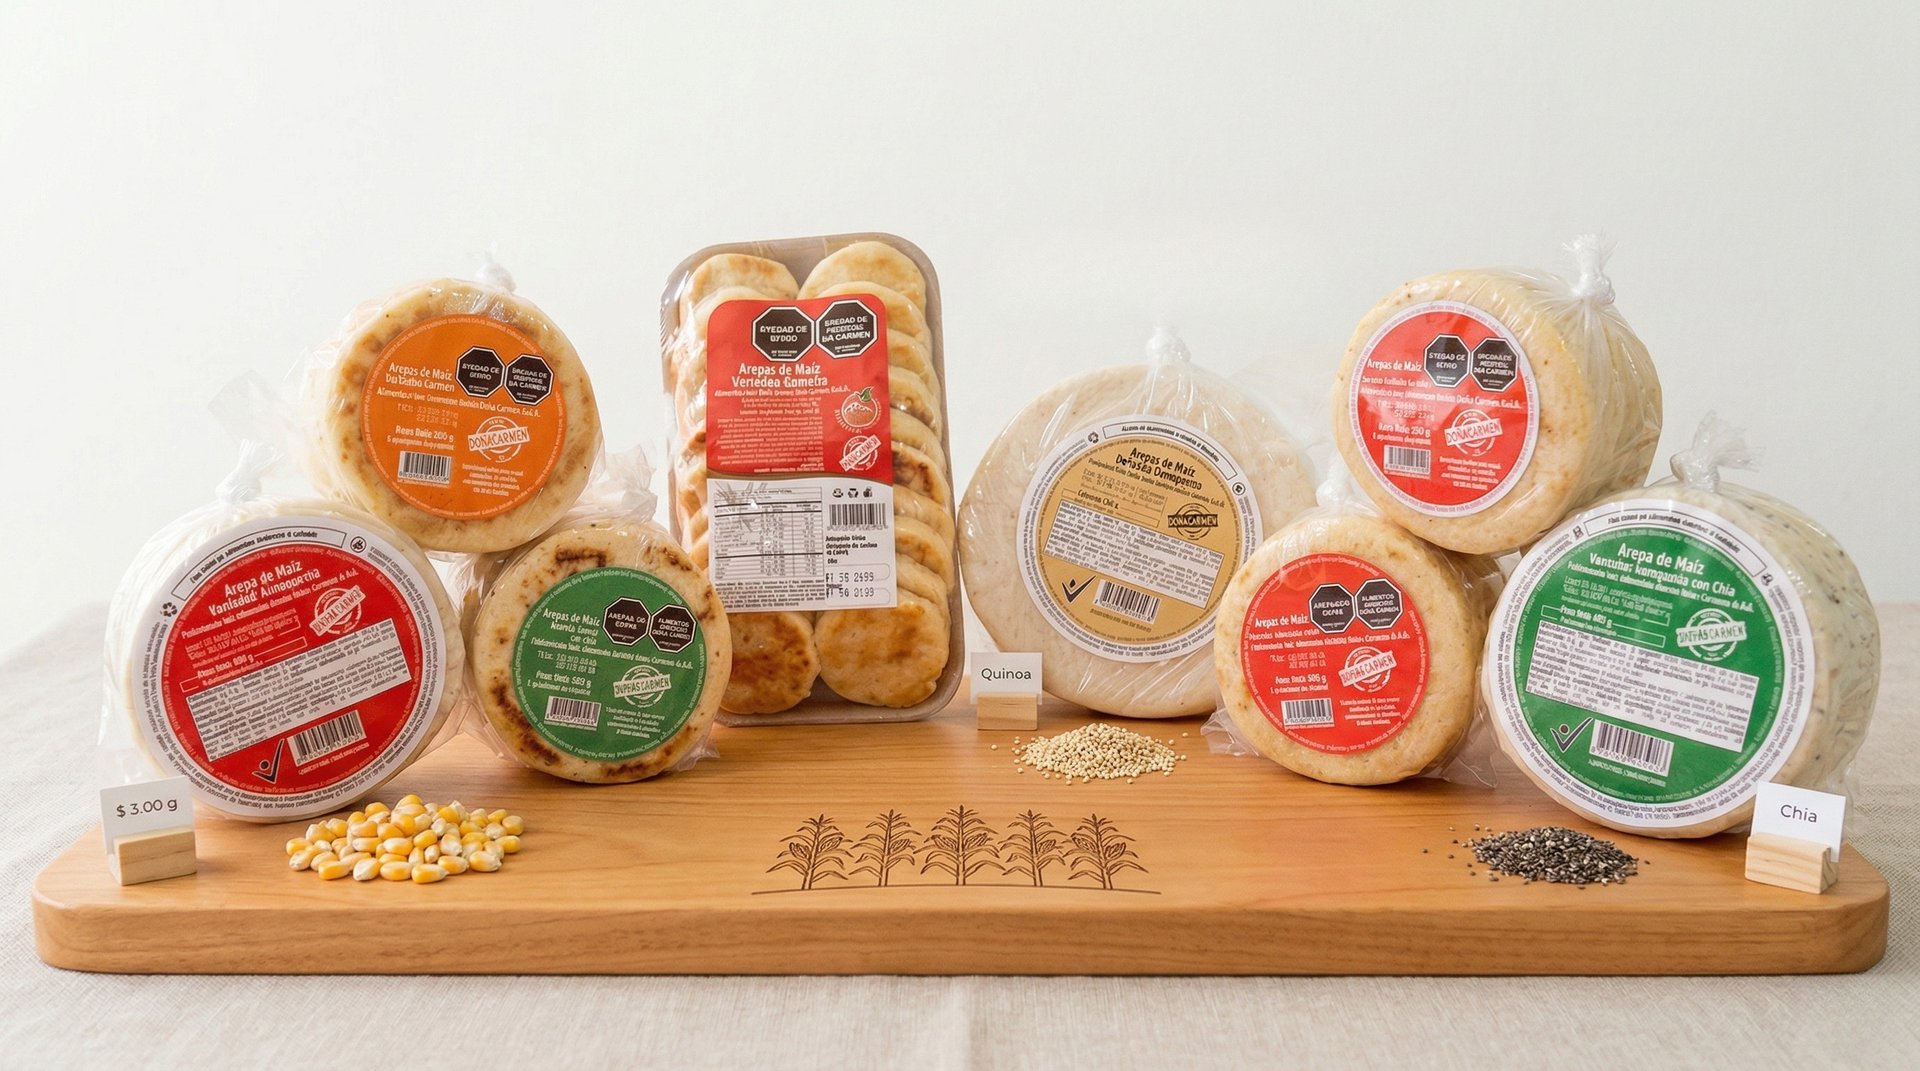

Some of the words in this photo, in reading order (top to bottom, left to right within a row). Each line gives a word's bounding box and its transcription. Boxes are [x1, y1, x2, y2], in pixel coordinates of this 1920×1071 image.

[835, 331, 871, 342] CARMEN
[389, 362, 418, 376] Arepas
[420, 366, 431, 378] de
[739, 363, 776, 377] Arepas
[779, 364, 792, 375] de
[795, 362, 821, 375] Maíz
[1367, 358, 1392, 371] Arepas
[1393, 360, 1403, 370] de
[424, 380, 455, 392] Carmen
[1130, 447, 1160, 466] Arepas
[1162, 458, 1173, 469] de
[1174, 461, 1196, 478] Maíz
[1618, 543, 1653, 564] Arepa
[1656, 552, 1671, 567] de
[1675, 556, 1706, 575] Maíz
[224, 578, 258, 598] Arepa
[260, 571, 274, 584] de
[275, 560, 303, 578] Maíz
[1691, 579, 1710, 591] con
[543, 608, 569, 622] Arepas
[570, 613, 581, 624] de
[1280, 616, 1289, 625] de
[981, 667, 1031, 681] Quinoa
[116, 804, 126, 818] $
[130, 799, 163, 815] 3.00
[167, 799, 177, 812] g
[1780, 804, 1817, 823] Chia
